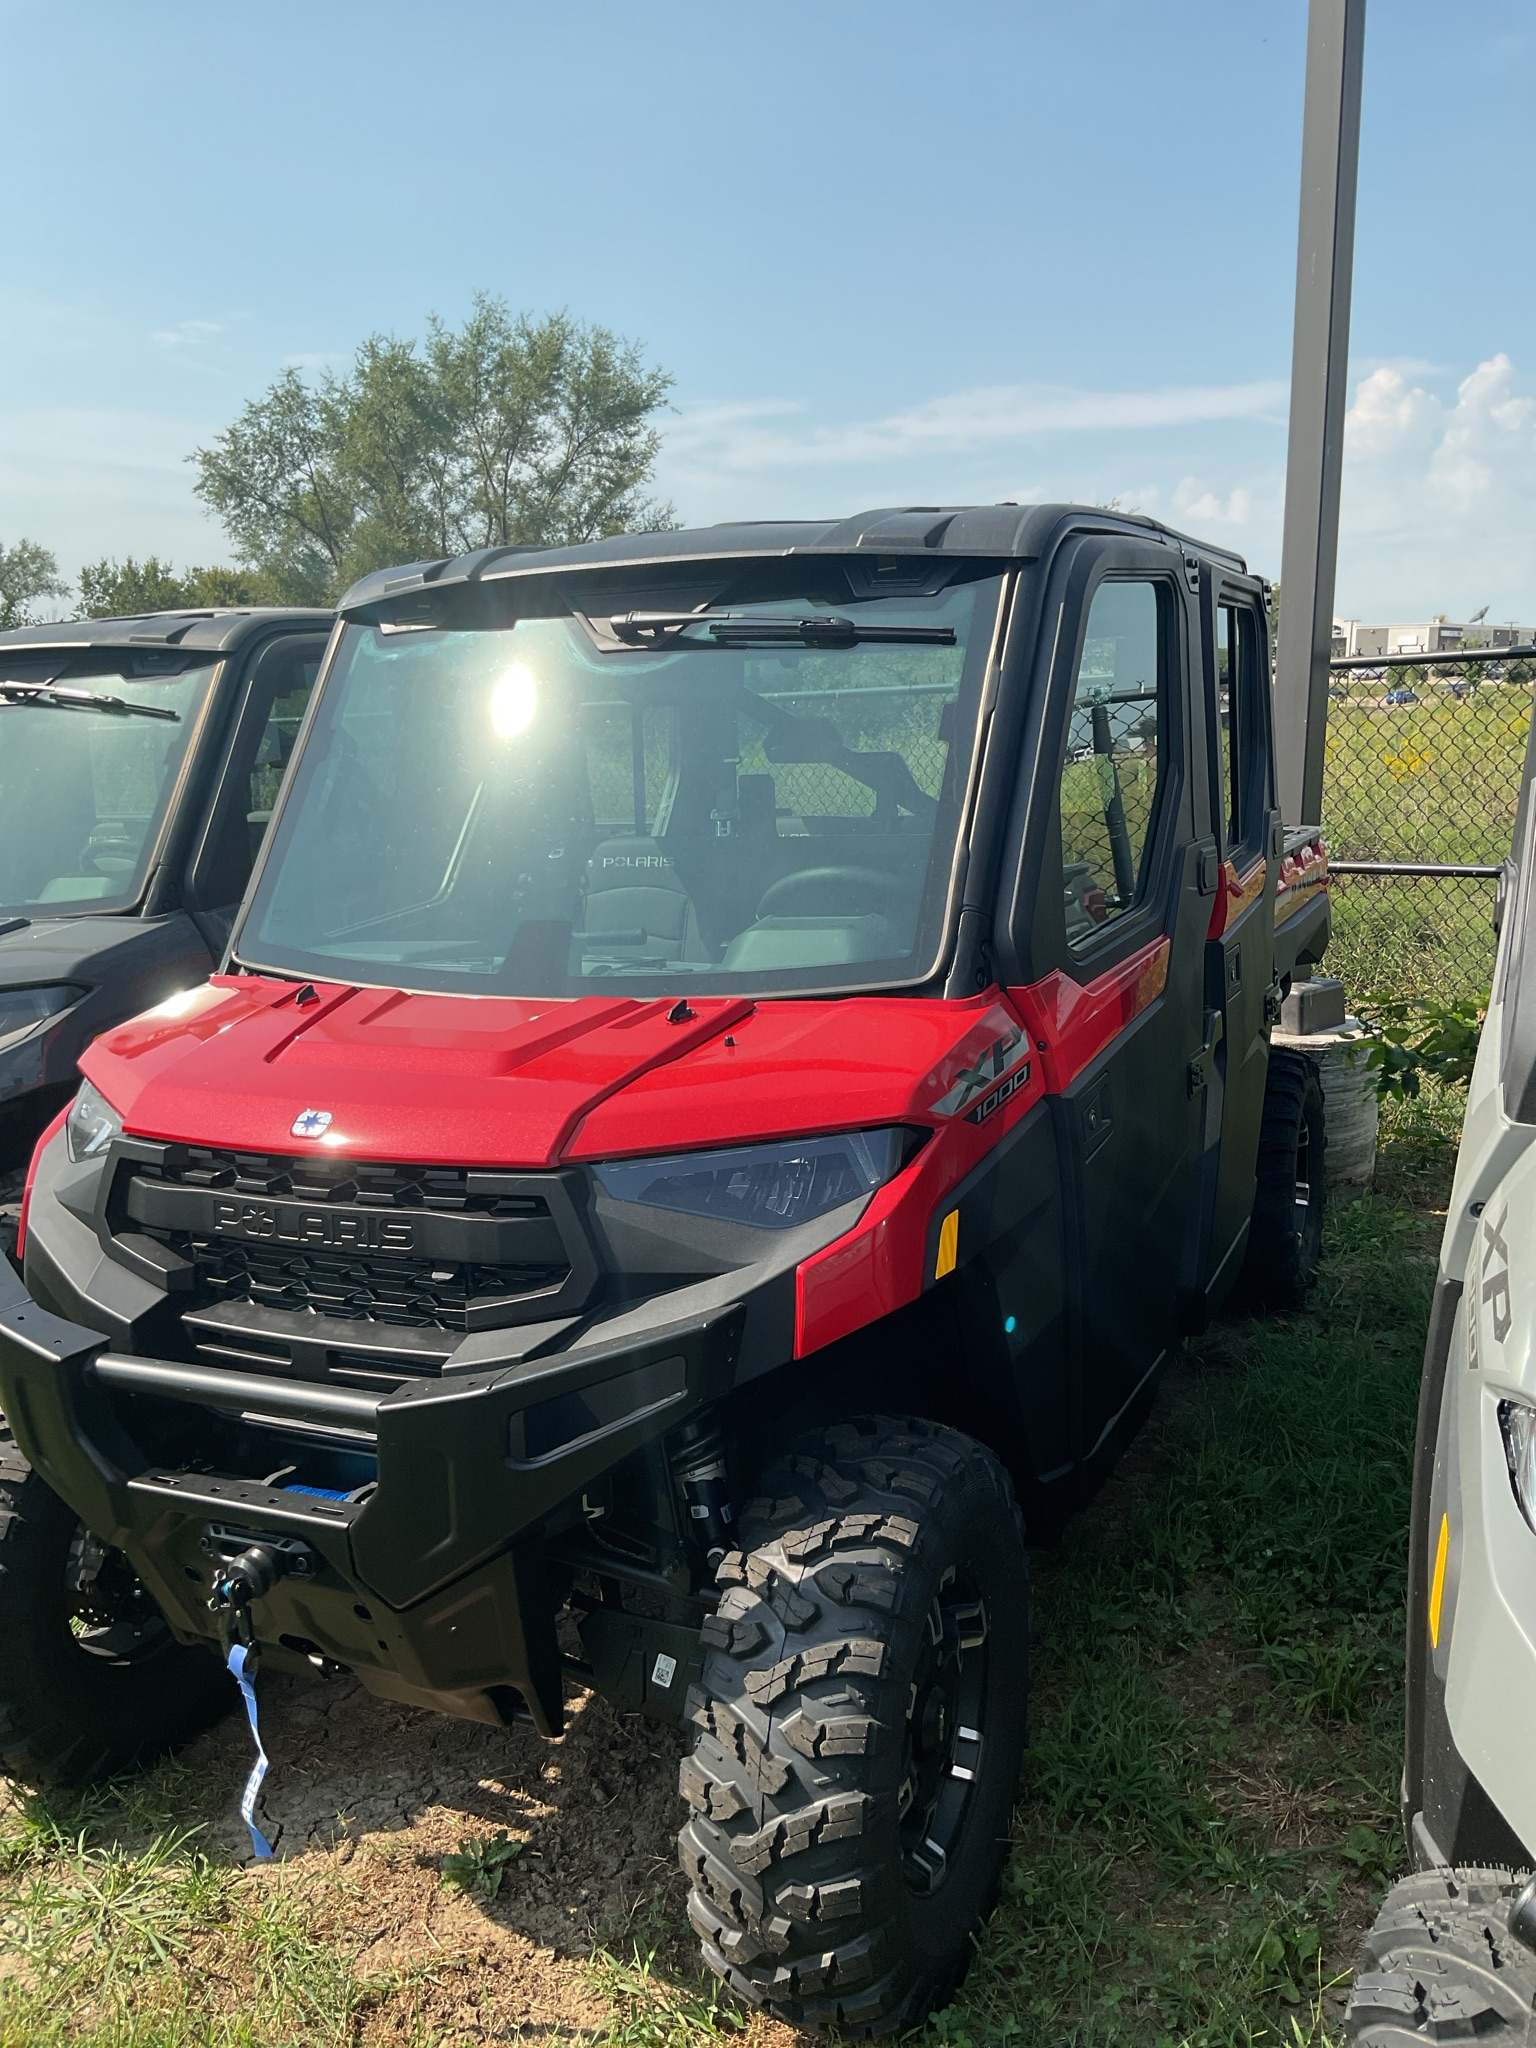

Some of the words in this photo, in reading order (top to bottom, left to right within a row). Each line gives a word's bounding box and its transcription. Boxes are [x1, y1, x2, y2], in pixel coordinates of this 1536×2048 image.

[603, 855, 675, 869] POLARIS
[954, 1027, 1022, 1112] XP
[976, 1066, 1028, 1122] 1000
[214, 1202, 415, 1249] POLARIS
[1482, 1201, 1512, 1344] XP
